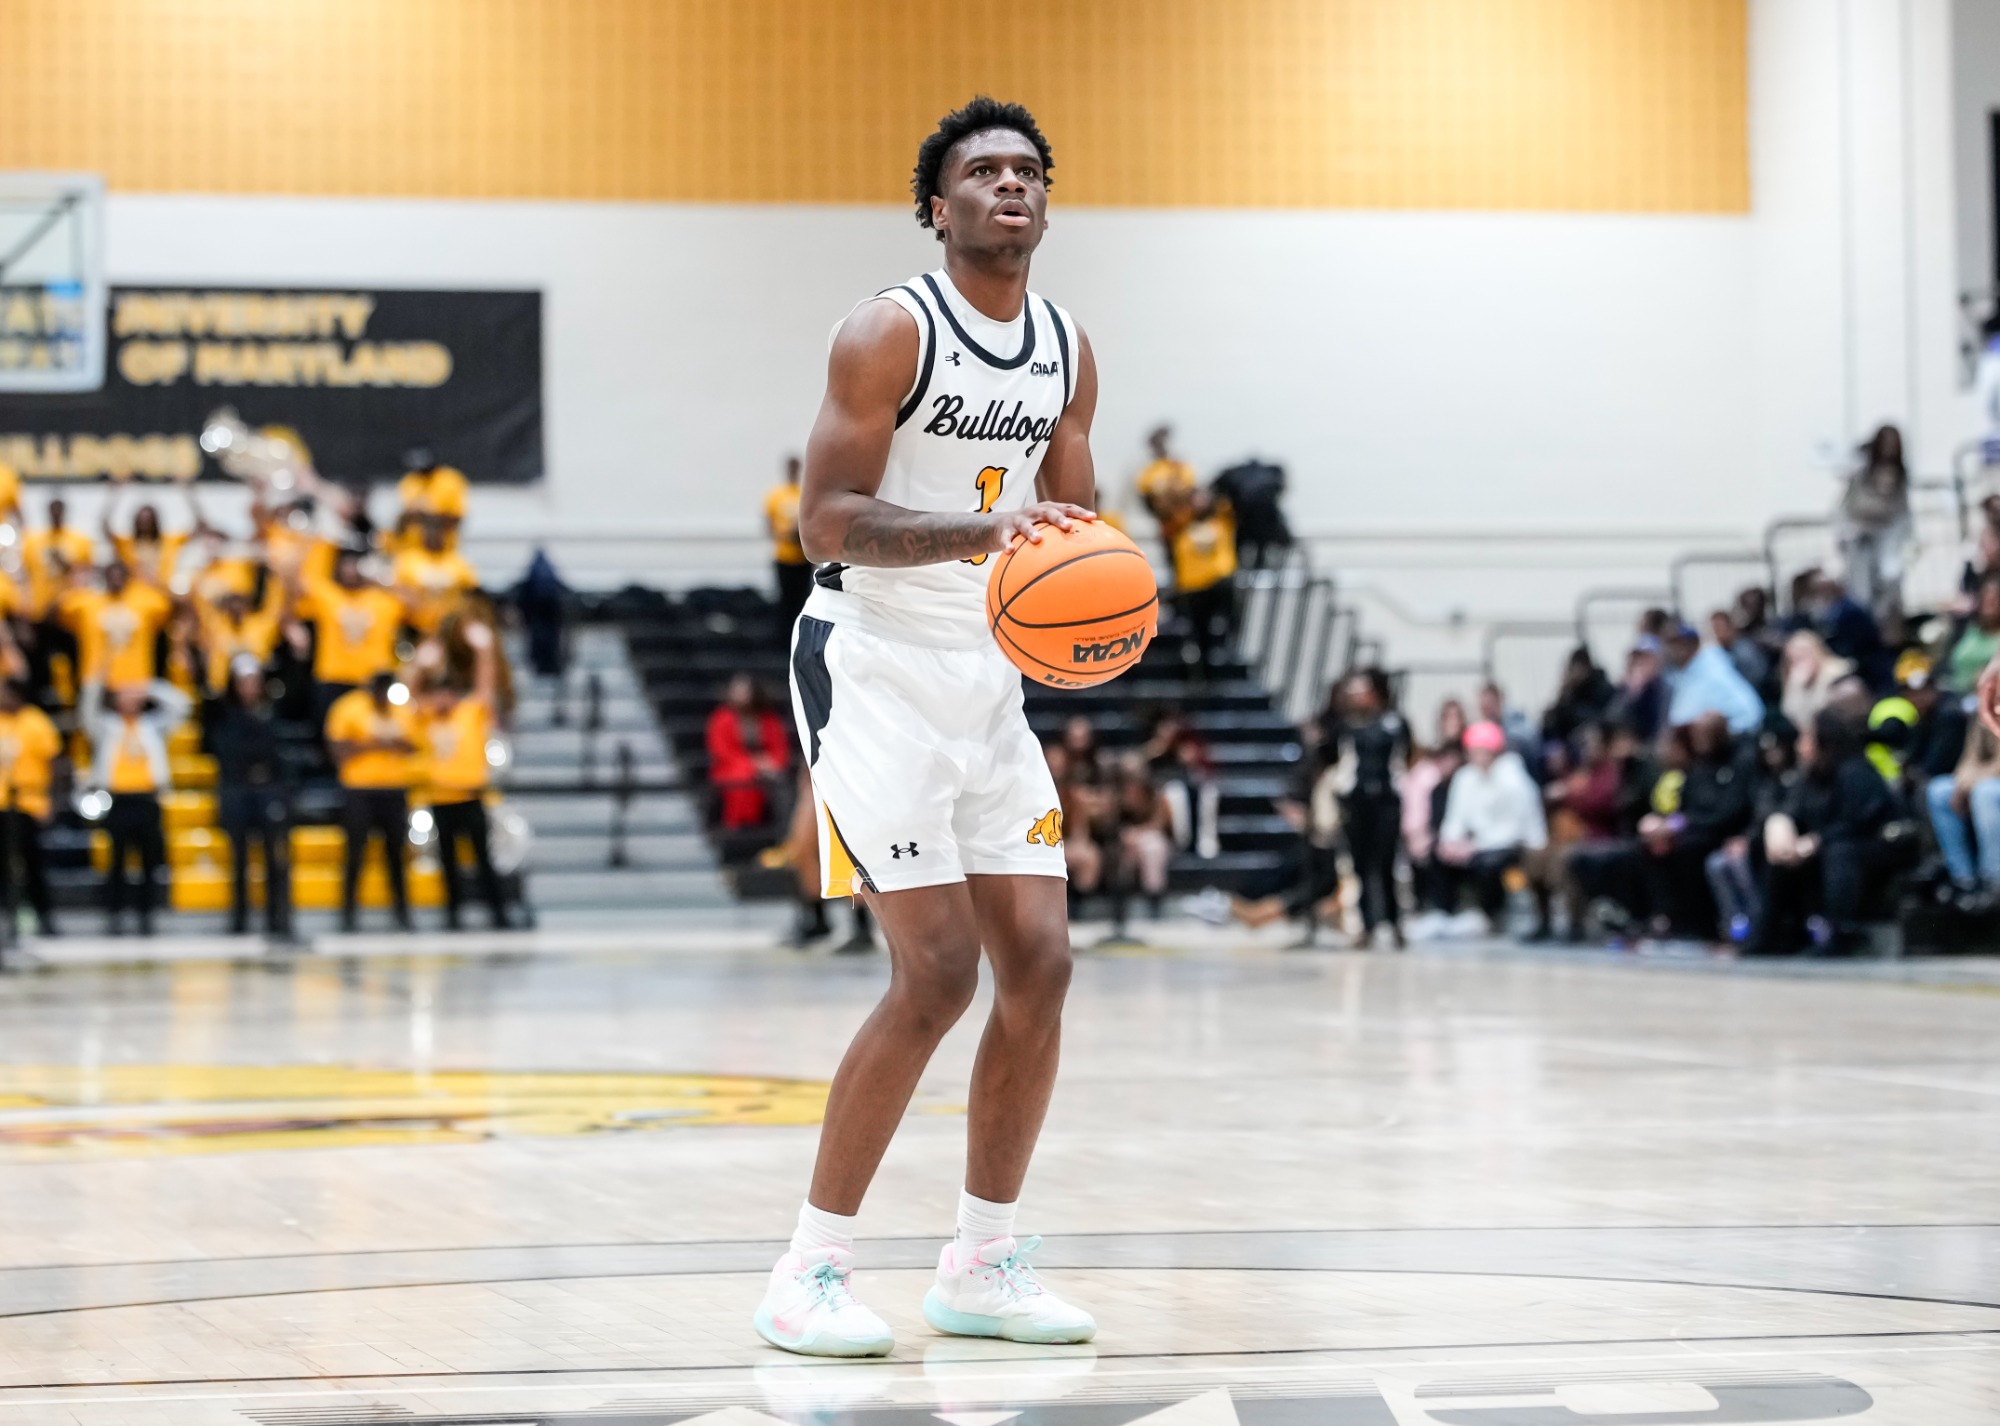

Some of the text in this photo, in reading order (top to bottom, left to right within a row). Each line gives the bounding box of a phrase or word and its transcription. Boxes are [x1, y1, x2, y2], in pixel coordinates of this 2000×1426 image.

[117, 341, 188, 387] OF
[195, 341, 454, 389] MARYLAND
[1030, 361, 1059, 378] CIAA
[1072, 626, 1146, 664] NCAA
